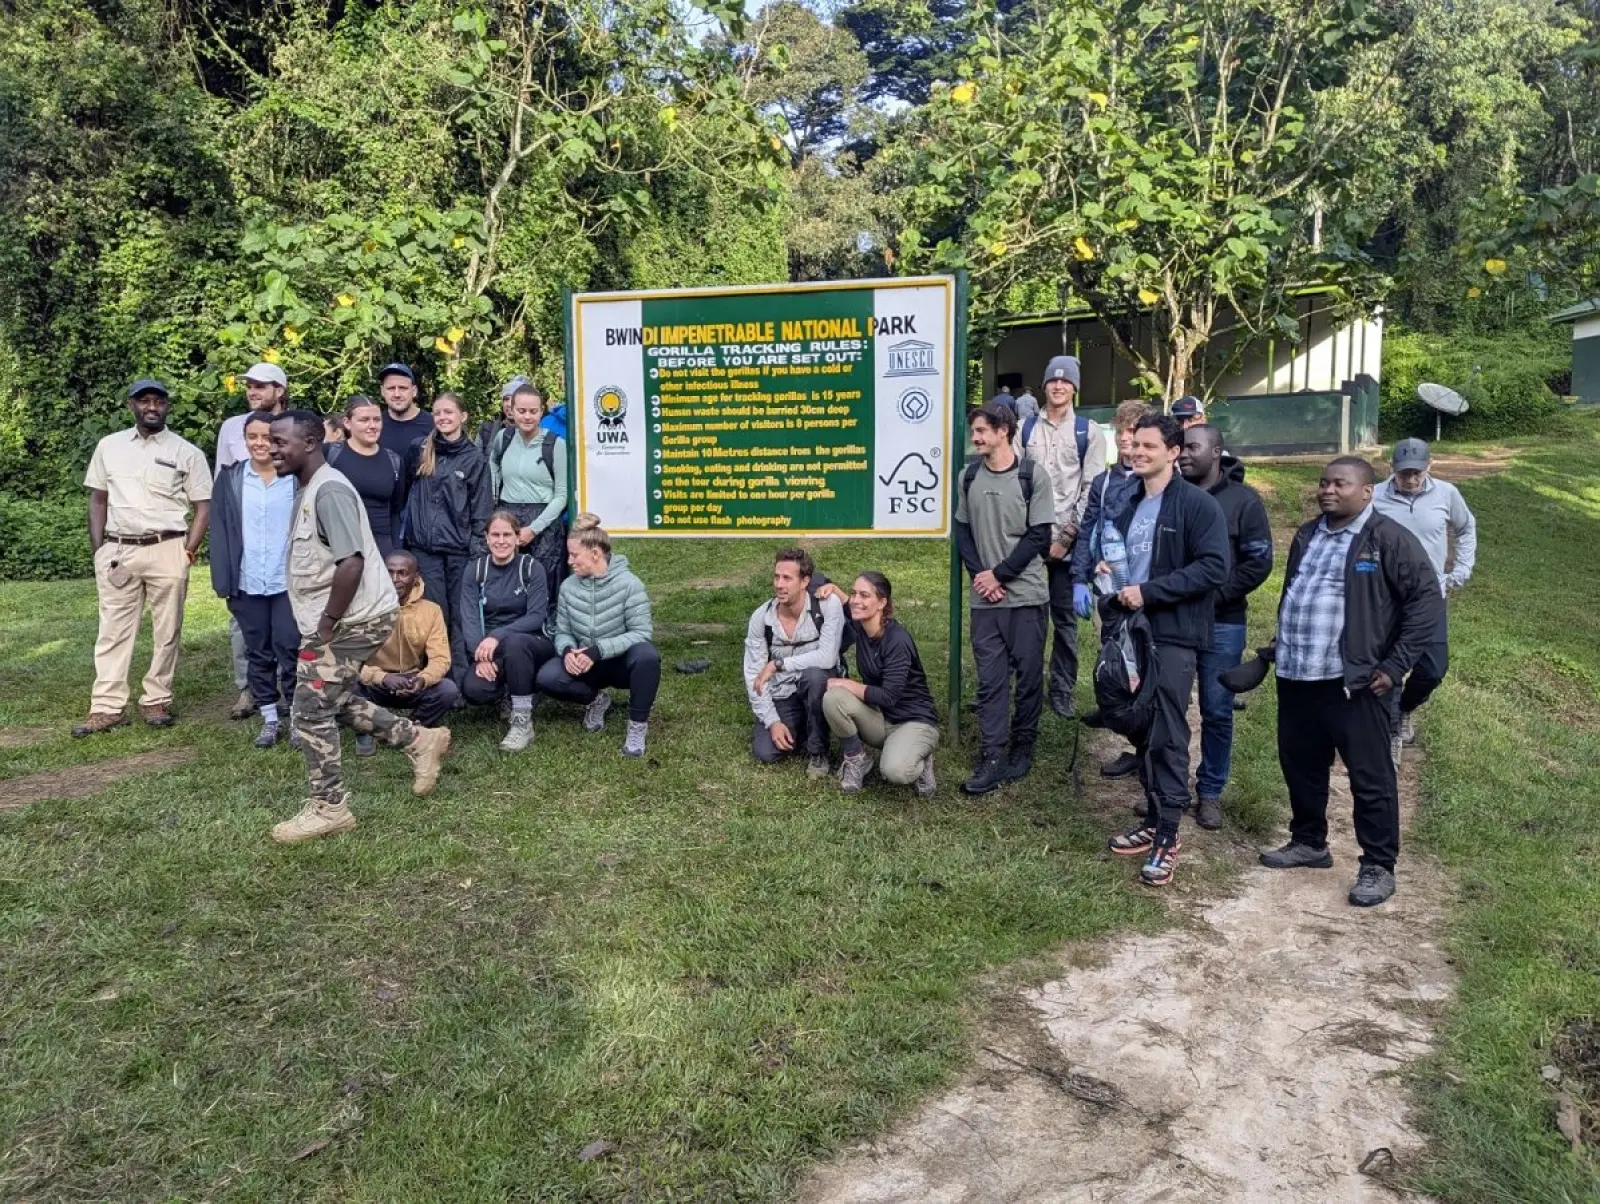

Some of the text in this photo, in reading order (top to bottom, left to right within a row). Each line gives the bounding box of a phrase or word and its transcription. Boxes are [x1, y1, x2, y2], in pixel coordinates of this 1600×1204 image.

[605, 314, 917, 346] BWINDI IMPENETRABLE NATIONAL PARK
[647, 340, 868, 357] GORILLA TRACKING RULES:
[657, 351, 862, 368] BEFORE YOU ARE SET OUT:
[889, 350, 933, 369] UNESCO
[659, 363, 852, 378] Do not visit the gorillas if you have a cold or
[660, 379, 759, 391] other infectious illness
[661, 389, 861, 404] Minimum age for tracking gorillas is 15 years
[661, 407, 692, 417] Human
[693, 407, 720, 416] waste
[721, 406, 751, 416] should
[752, 406, 765, 415] be
[800, 404, 825, 415] 30cm
[827, 404, 850, 416] deep
[661, 421, 702, 432] Maximum
[704, 420, 738, 431] number
[739, 419, 749, 429] of
[751, 418, 784, 429] visitors
[786, 418, 794, 428] is
[804, 419, 840, 431] persons
[842, 418, 857, 429] per
[596, 431, 629, 444] UWA
[662, 435, 717, 446] Gorilla group
[662, 448, 699, 459] Maintain
[750, 446, 788, 457] distance
[790, 445, 811, 456] from
[815, 445, 831, 456] the
[832, 444, 866, 457] gorillas
[662, 459, 868, 475] Smoking, eating and drinking are not permitted
[674, 476, 690, 487] the
[712, 475, 745, 489] during
[747, 475, 780, 489] gorilla
[784, 475, 826, 488] viewing
[662, 488, 835, 501] Visits are limited to one hour per gorilla
[663, 502, 723, 514] group per day
[888, 497, 936, 514] FSC
[662, 514, 792, 527] Do not use flash photography
